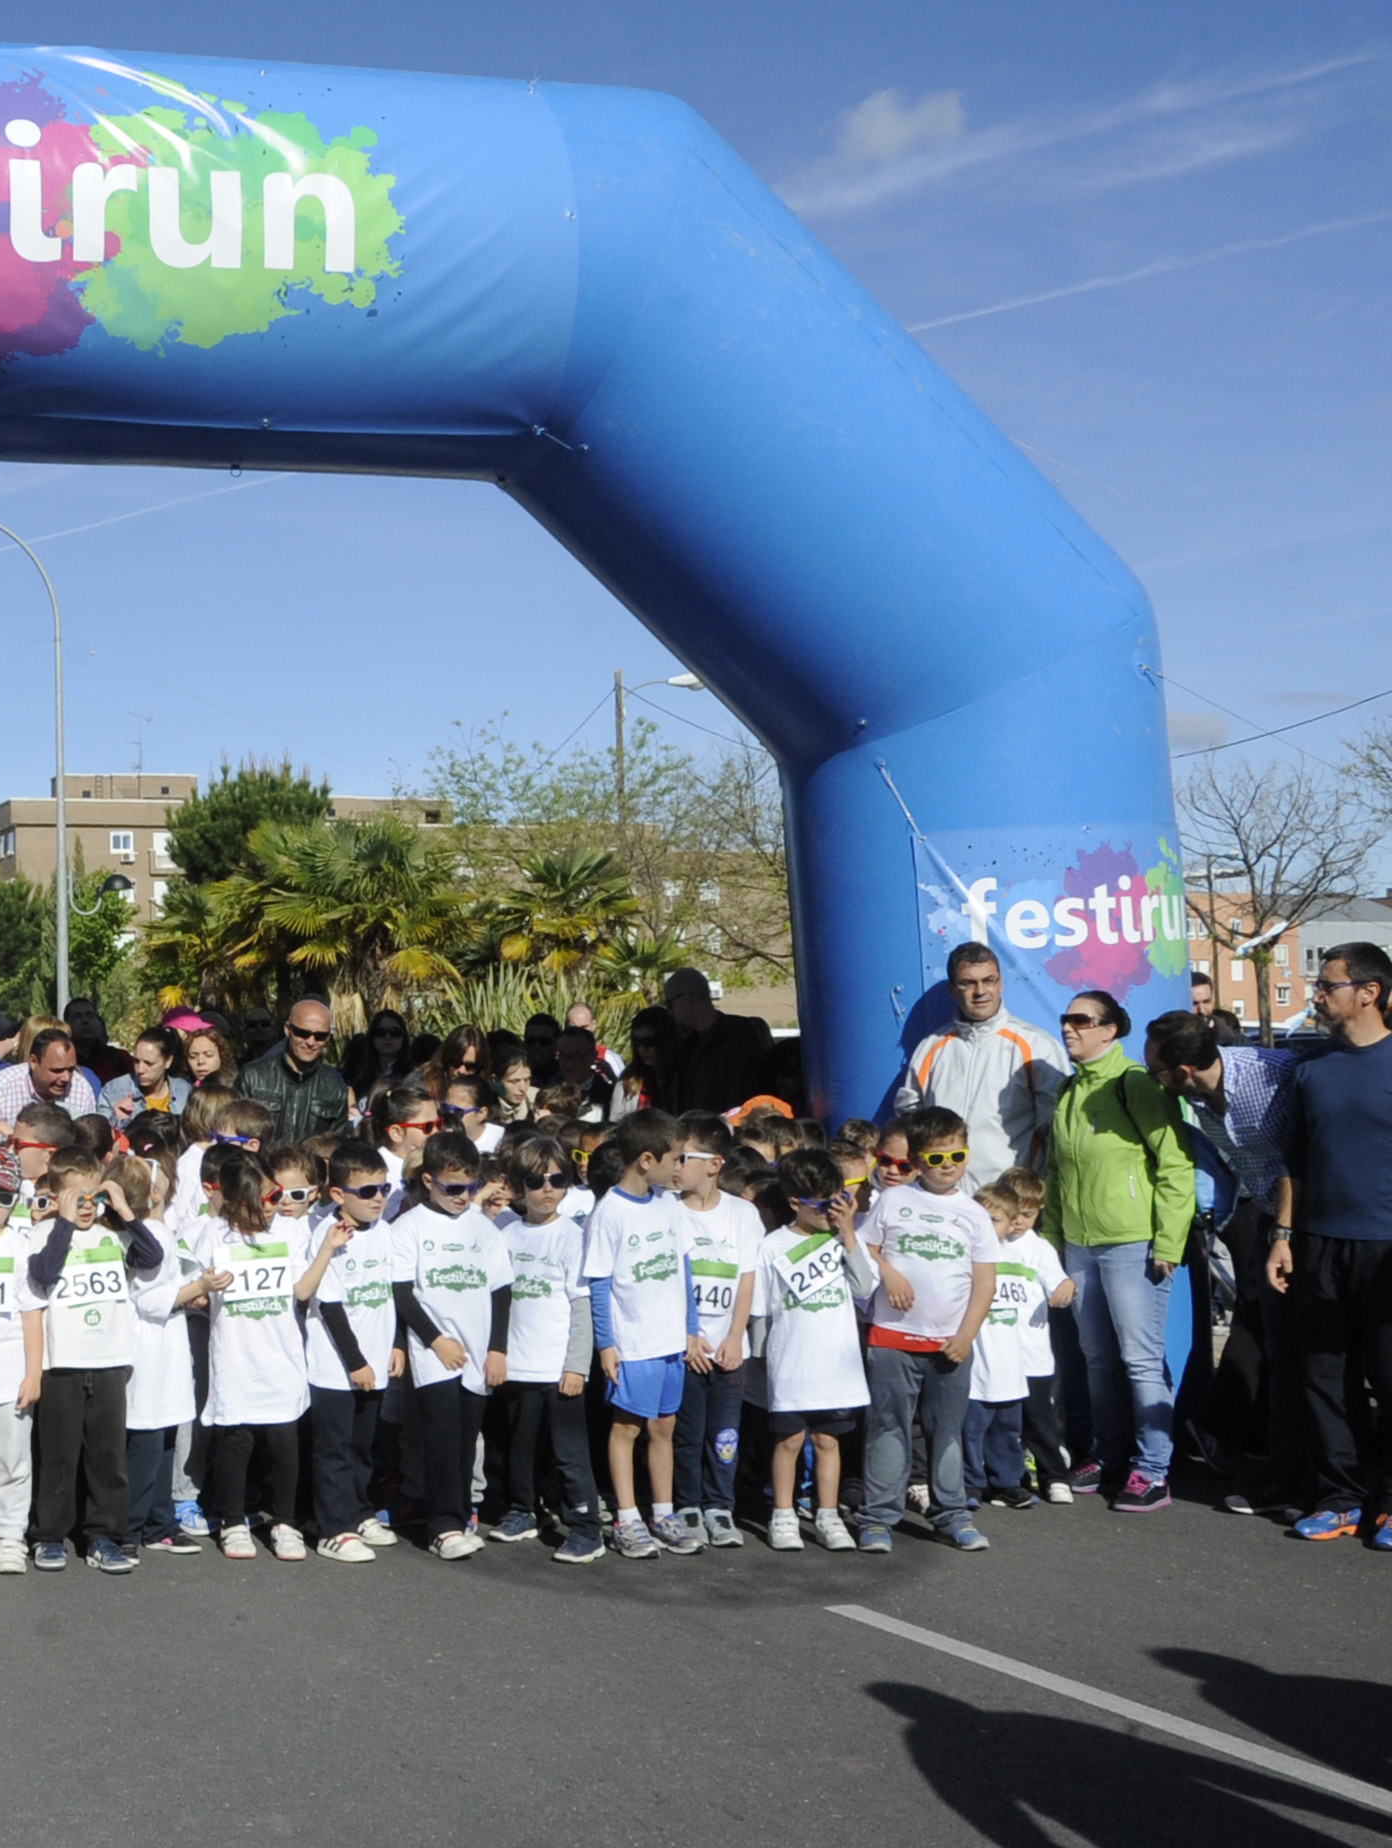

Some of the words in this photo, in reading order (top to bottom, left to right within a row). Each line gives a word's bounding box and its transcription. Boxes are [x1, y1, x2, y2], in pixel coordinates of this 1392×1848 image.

[961, 875, 1187, 949] festiru
[56, 1270, 122, 1299] 2563
[223, 1266, 286, 1293] 127
[993, 1282, 1027, 1303] 463
